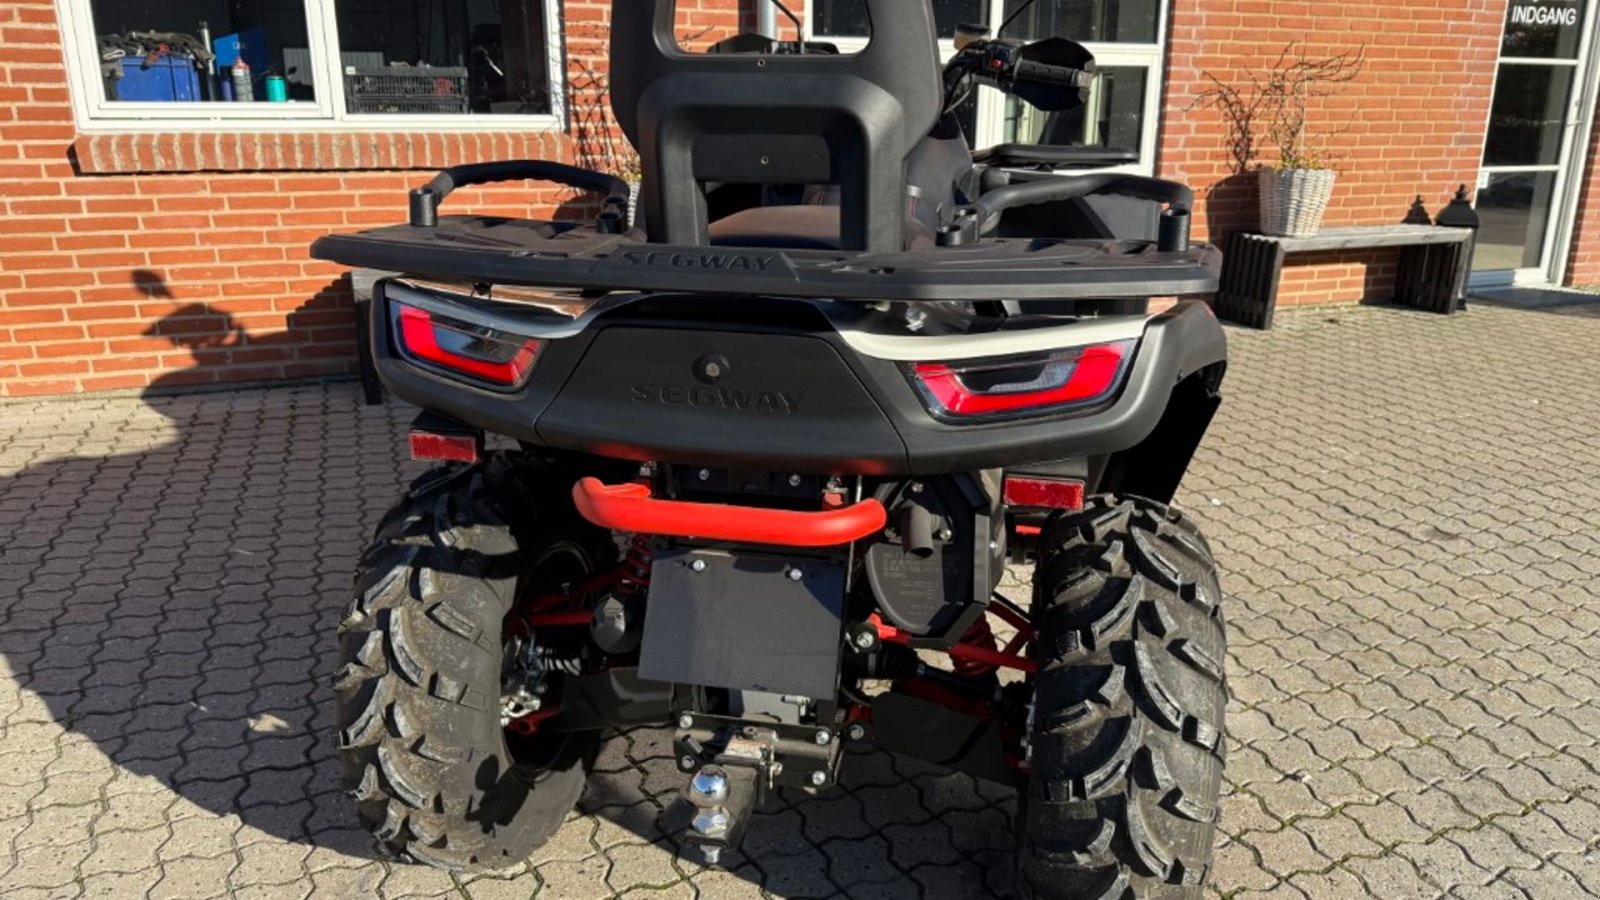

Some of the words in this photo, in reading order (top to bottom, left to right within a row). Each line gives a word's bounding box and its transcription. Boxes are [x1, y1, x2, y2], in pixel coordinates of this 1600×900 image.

[1511, 5, 1576, 26] INDGANG
[621, 251, 774, 270] SEGWAY
[629, 385, 805, 414] SEGWAY
